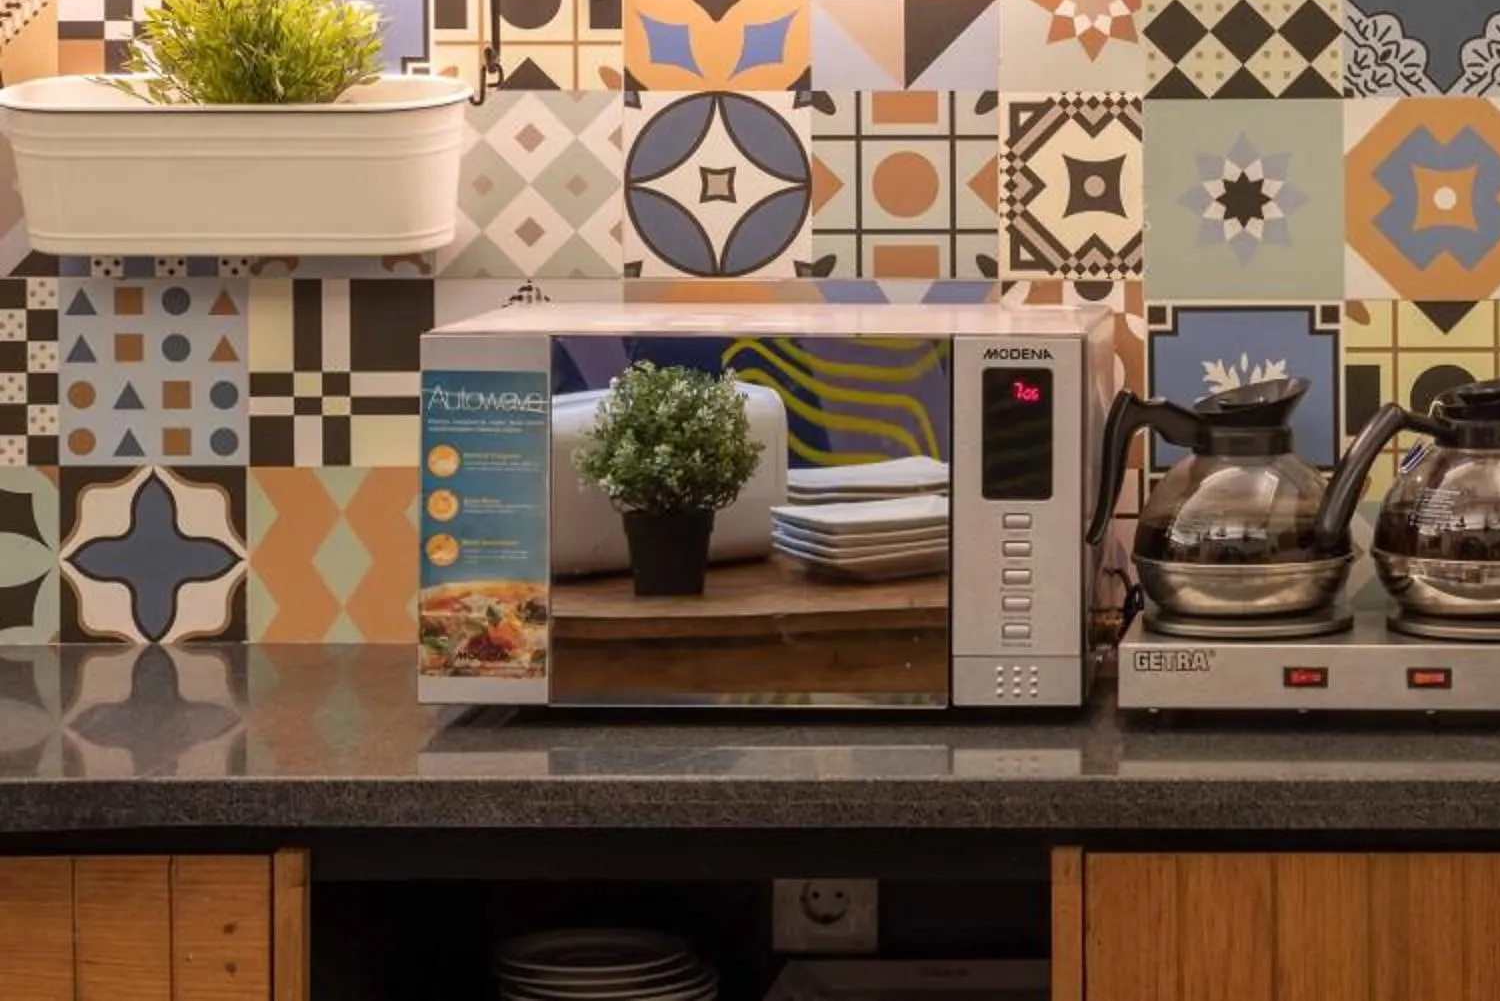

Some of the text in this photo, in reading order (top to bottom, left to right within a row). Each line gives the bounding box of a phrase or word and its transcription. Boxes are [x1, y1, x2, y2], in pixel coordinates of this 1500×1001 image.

[983, 348, 1054, 360] MODENA
[427, 385, 543, 412] Autowave
[1134, 650, 1210, 672] GETRA
